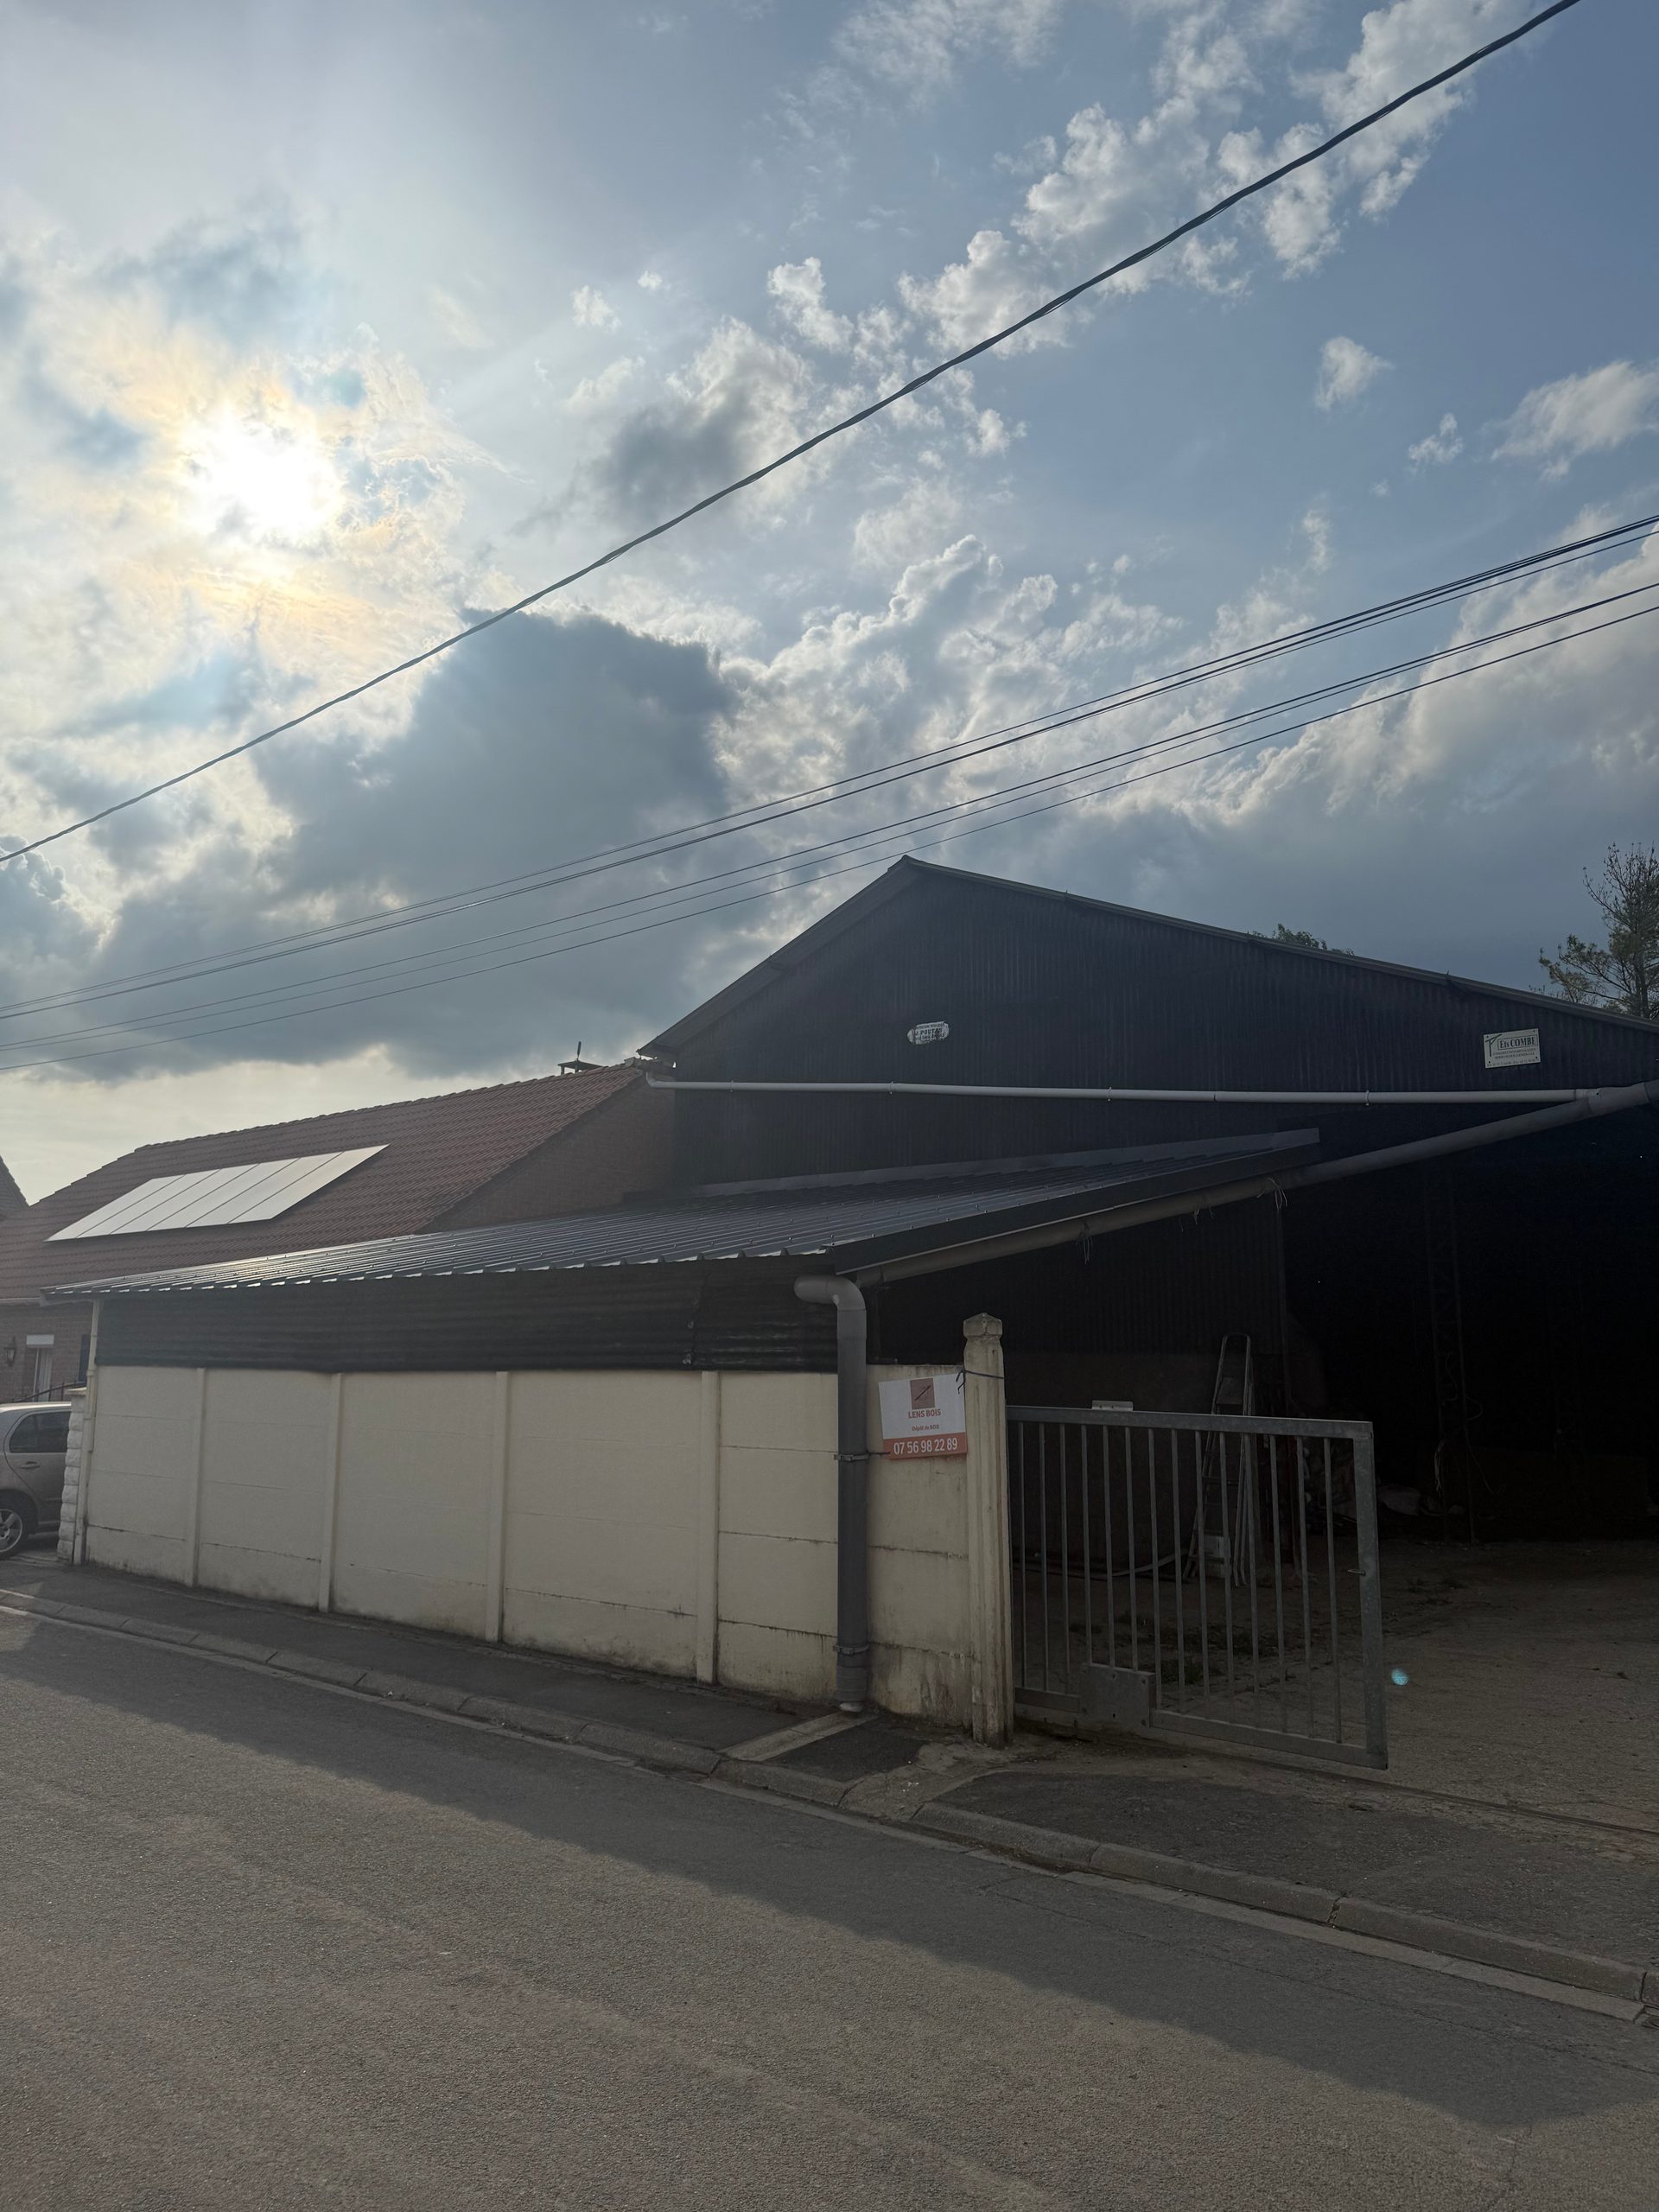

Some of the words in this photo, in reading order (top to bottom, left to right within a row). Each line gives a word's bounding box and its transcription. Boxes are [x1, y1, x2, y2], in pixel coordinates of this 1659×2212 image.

[908, 1410, 925, 1419] LENS
[926, 1408, 941, 1417] BOIS
[893, 1441, 905, 1455] 07
[906, 1440, 919, 1454] 56
[920, 1440, 932, 1452] 98
[934, 1439, 945, 1452] 22
[946, 1437, 957, 1451] 89
